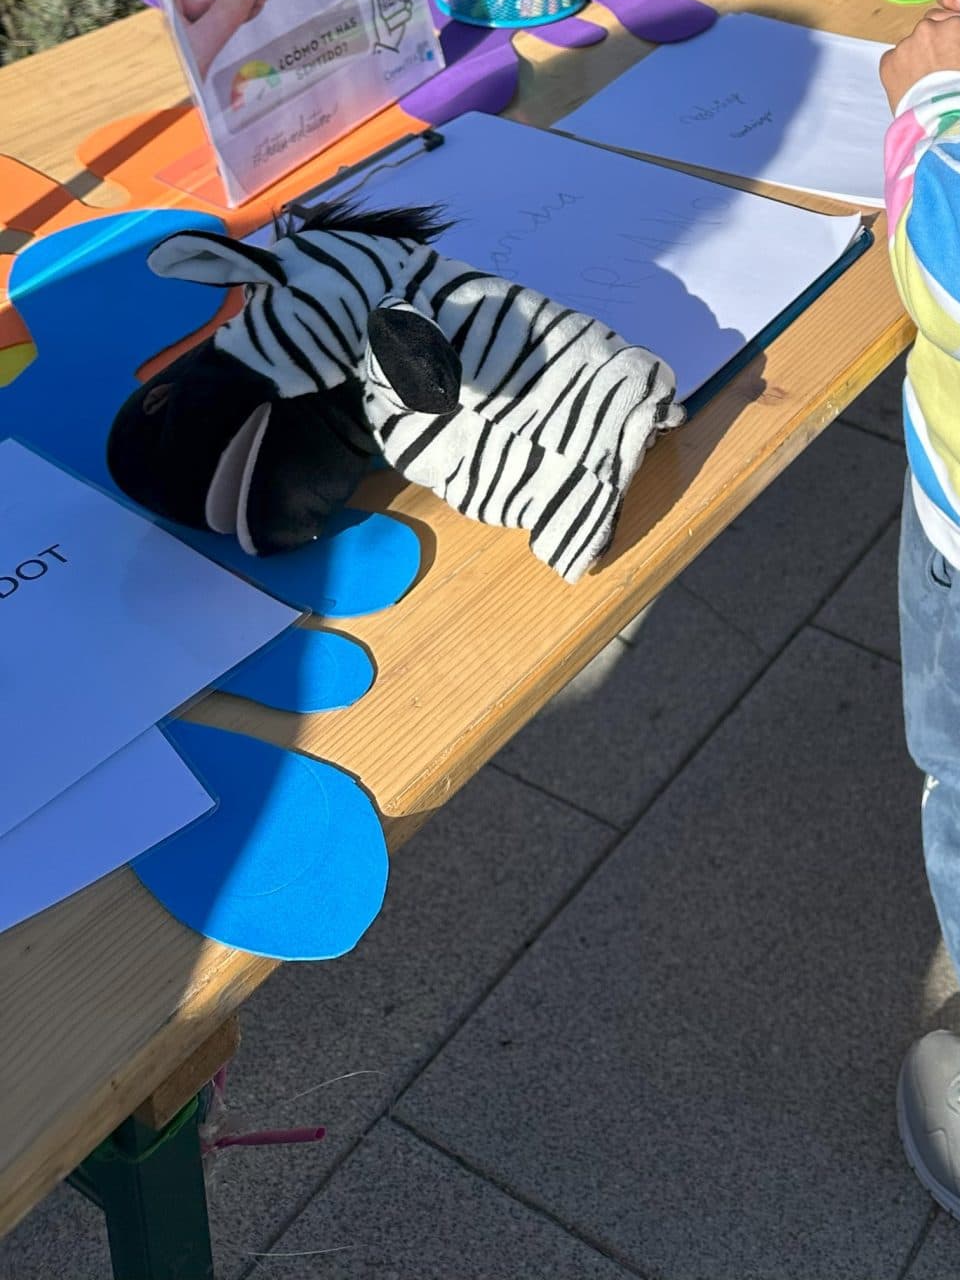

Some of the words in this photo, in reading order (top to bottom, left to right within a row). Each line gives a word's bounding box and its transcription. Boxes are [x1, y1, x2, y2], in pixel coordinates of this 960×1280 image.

[319, 31, 336, 45] TE
[336, 17, 358, 38] HAS
[0, 543, 68, 599] DOT
